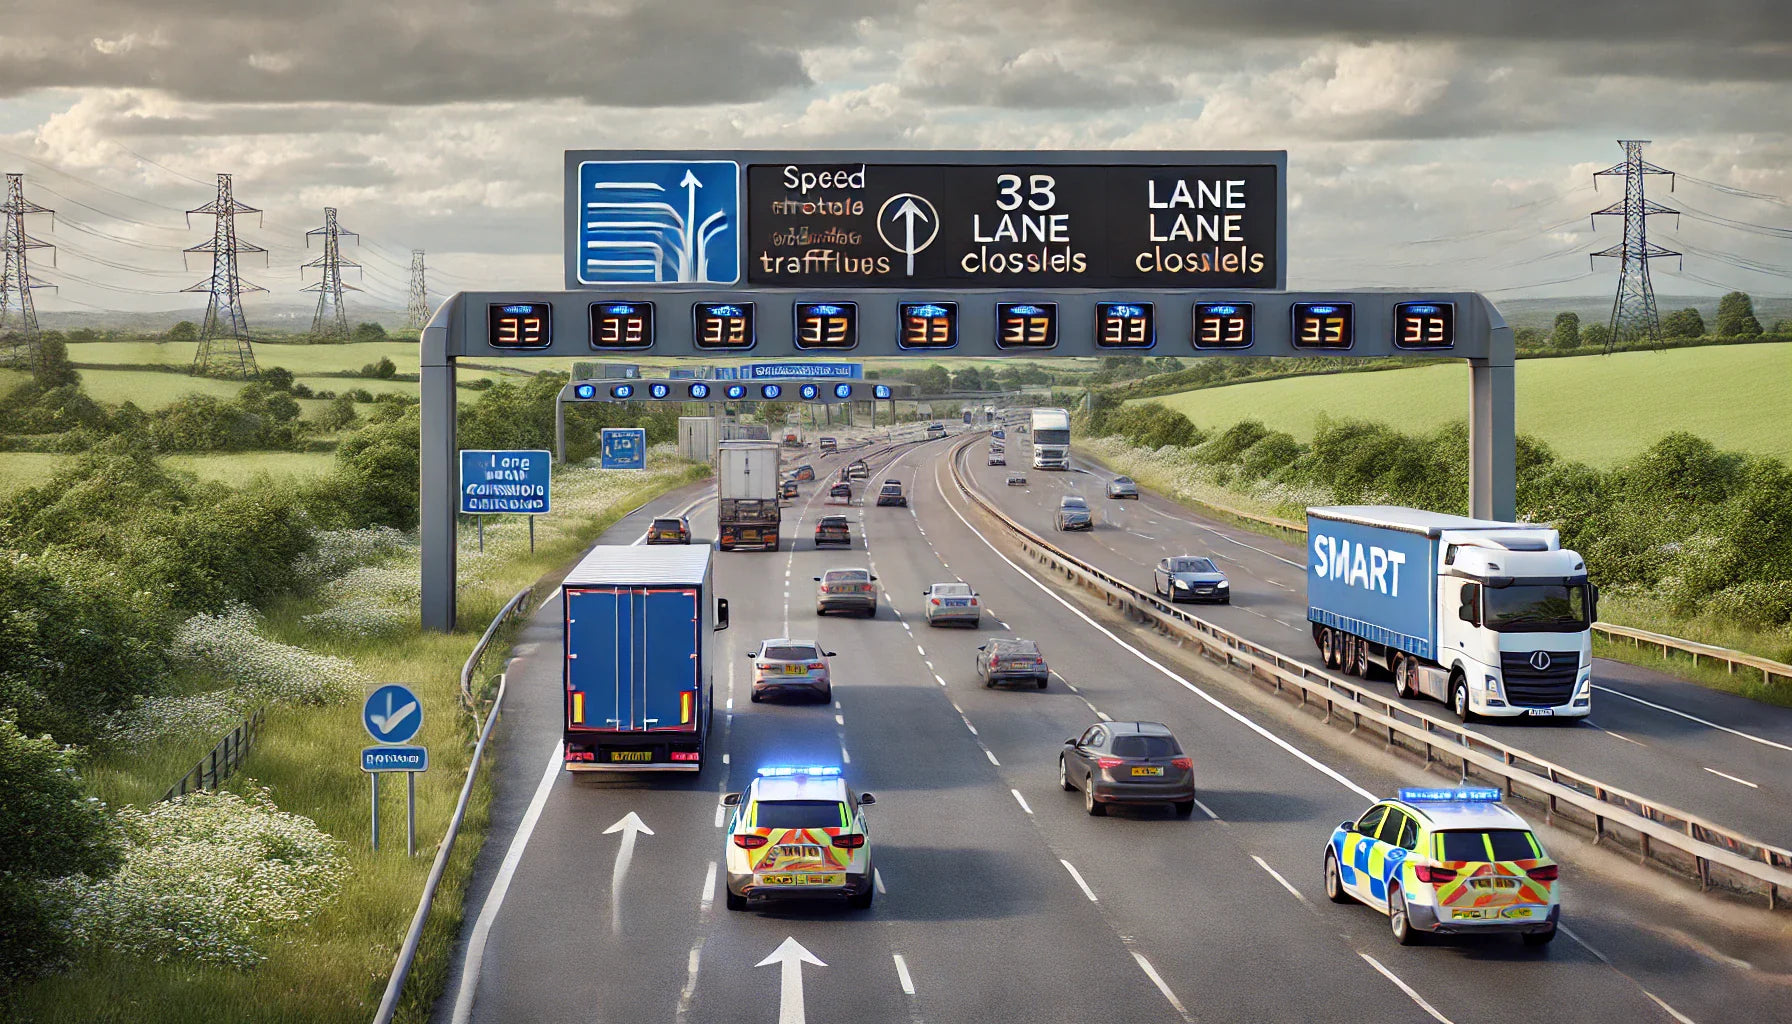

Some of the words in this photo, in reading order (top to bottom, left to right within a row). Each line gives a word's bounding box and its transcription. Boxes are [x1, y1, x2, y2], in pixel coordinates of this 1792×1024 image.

[784, 164, 865, 195] Speed
[1148, 179, 1246, 209] LANE
[973, 213, 1070, 243] LANE
[1149, 213, 1244, 242] LANE
[1314, 534, 1405, 597] SMART
